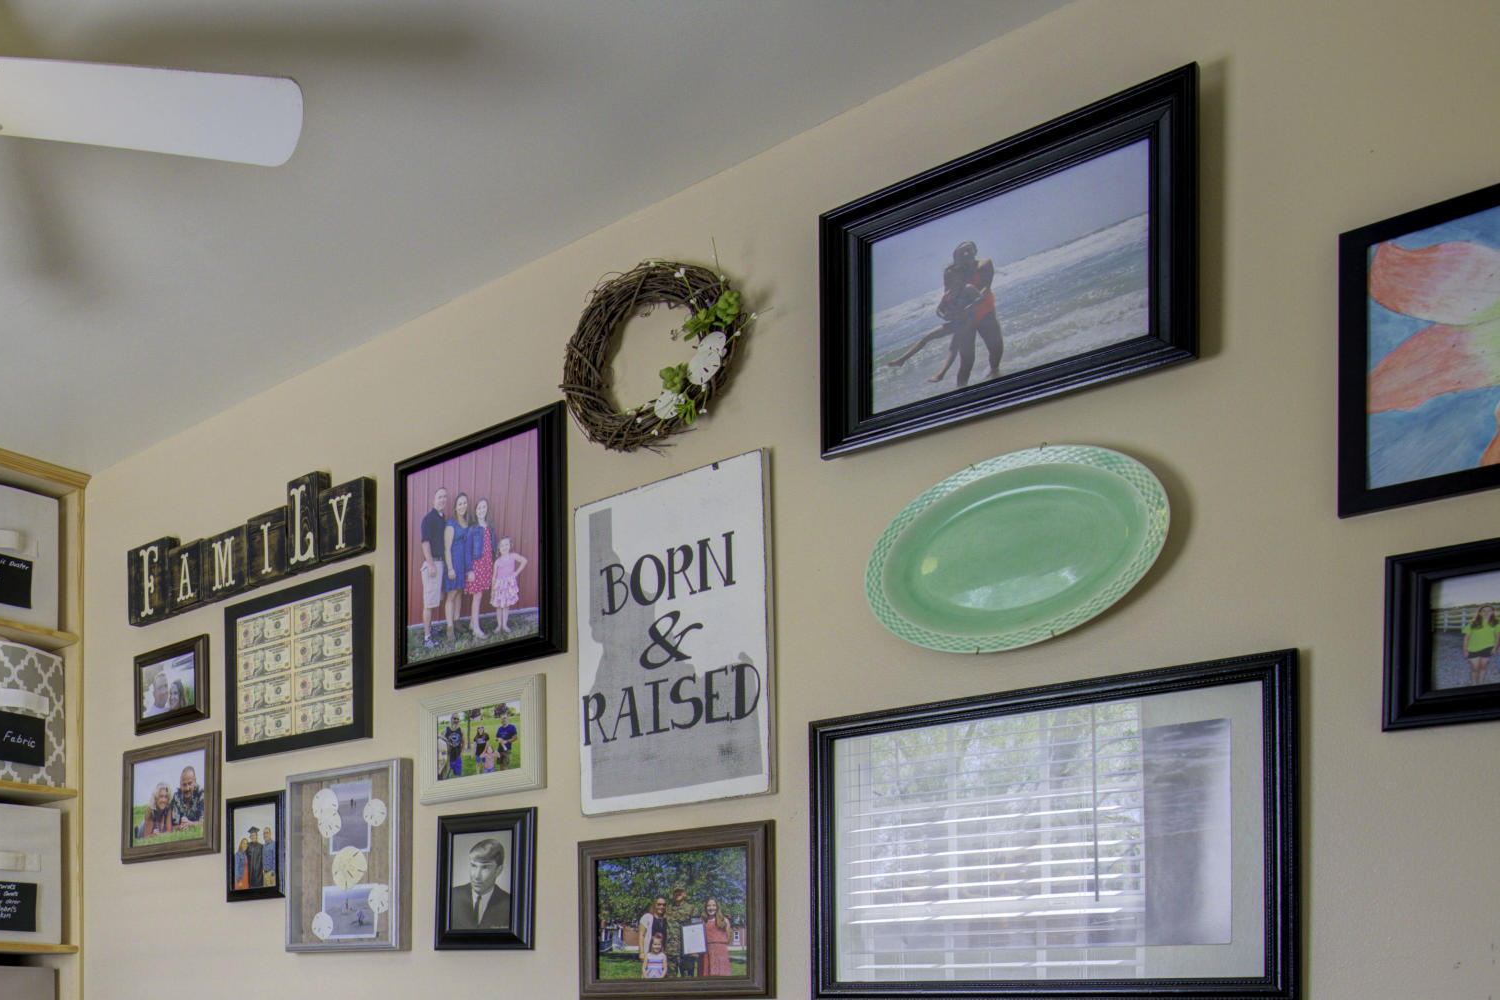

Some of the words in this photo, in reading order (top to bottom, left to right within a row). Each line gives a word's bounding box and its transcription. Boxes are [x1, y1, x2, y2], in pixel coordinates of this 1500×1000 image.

[140, 485, 352, 617] FAMILY
[600, 531, 736, 616] BORN
[639, 610, 704, 670] &
[3, 730, 36, 748] Fabric
[582, 663, 761, 746] RAISED
